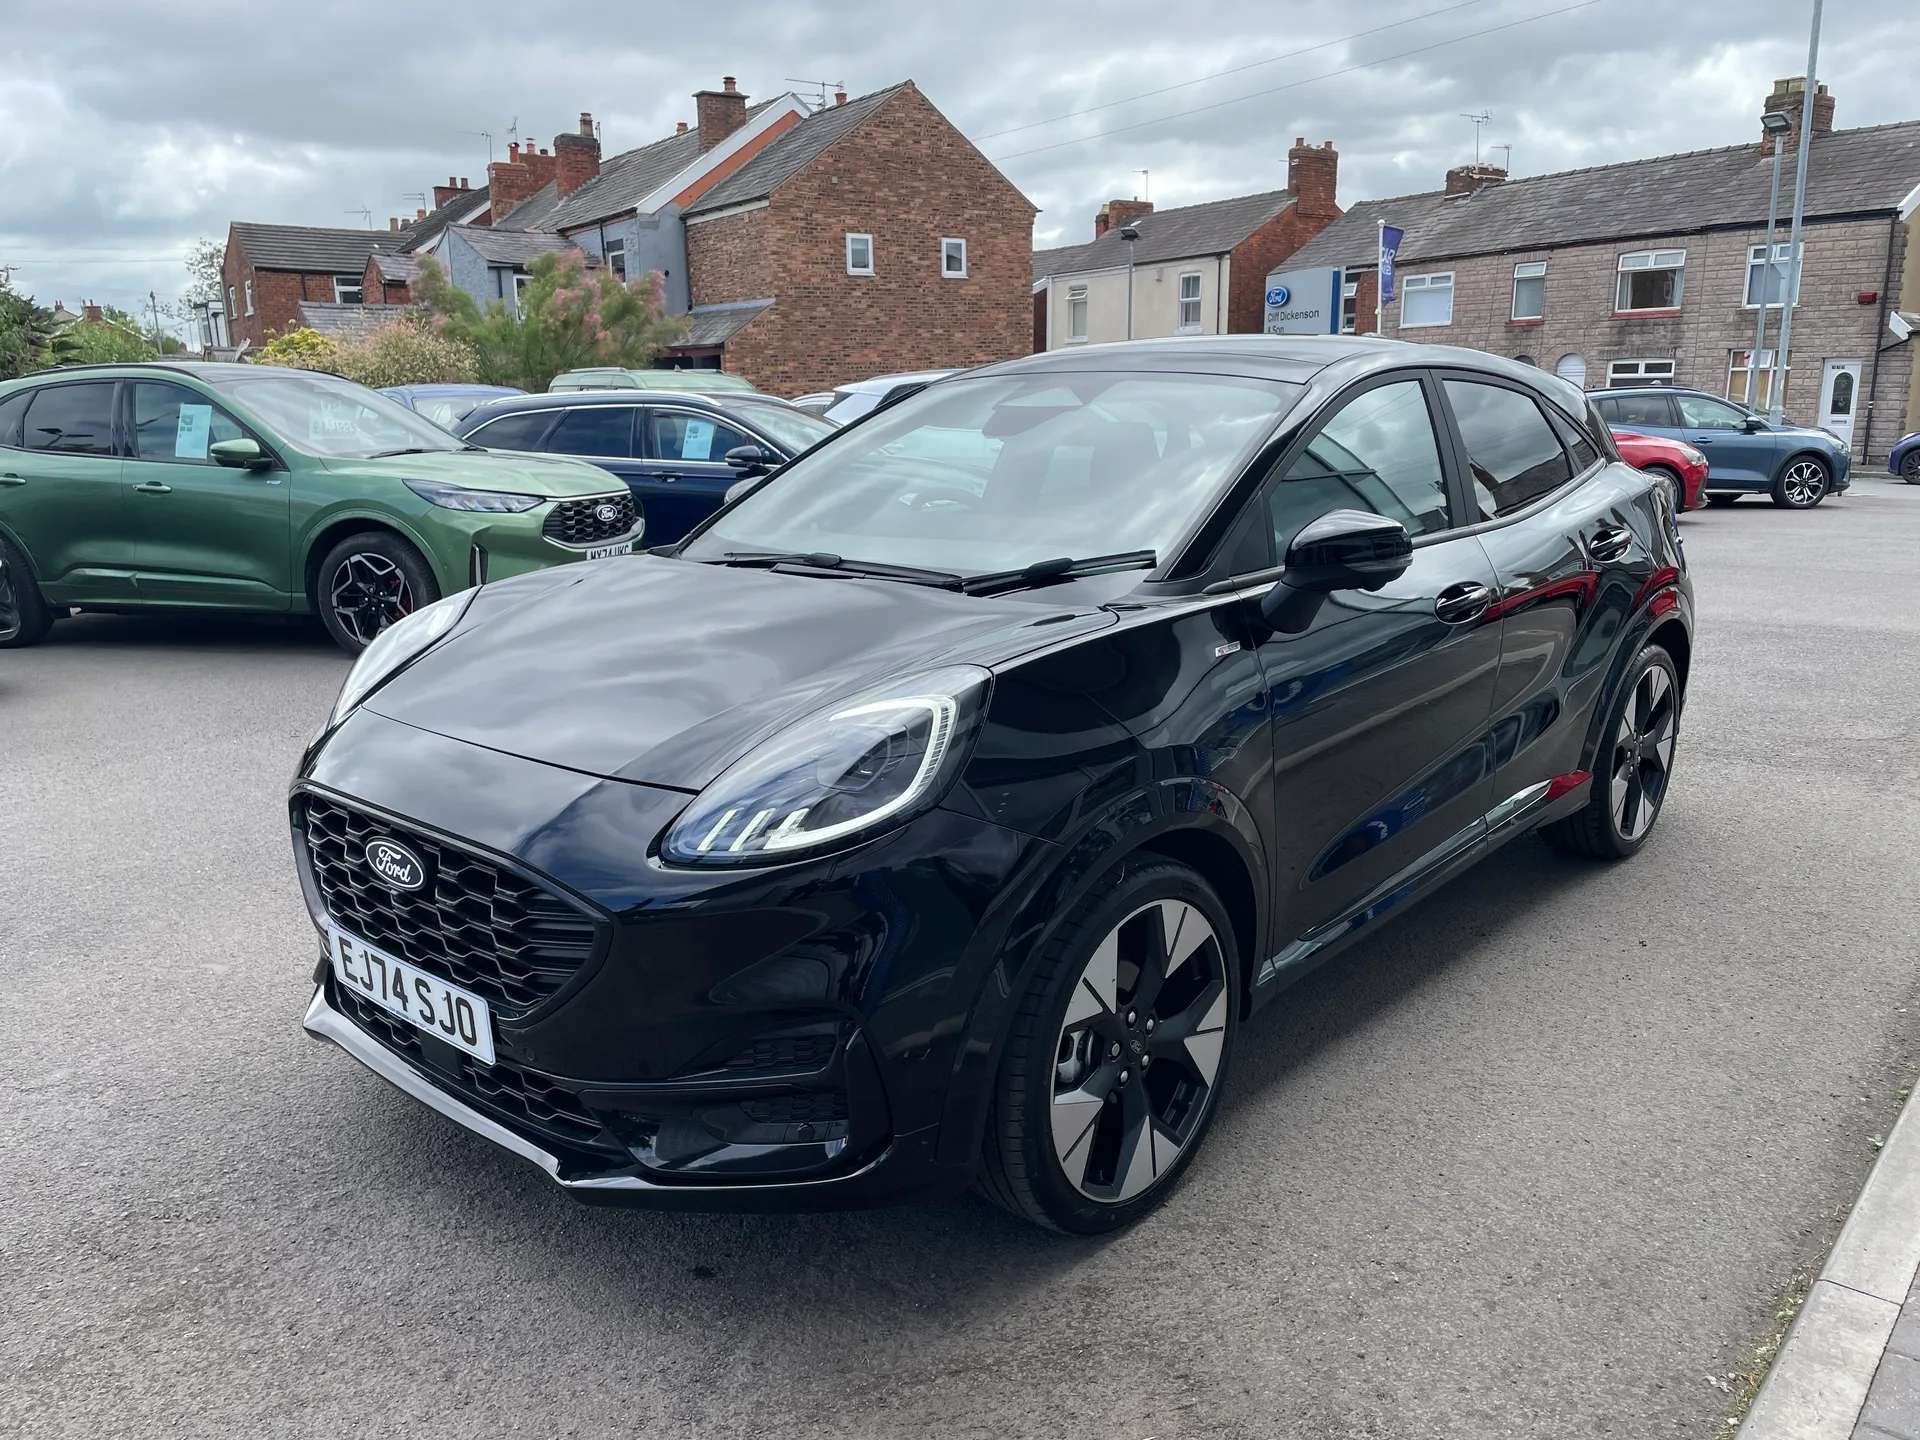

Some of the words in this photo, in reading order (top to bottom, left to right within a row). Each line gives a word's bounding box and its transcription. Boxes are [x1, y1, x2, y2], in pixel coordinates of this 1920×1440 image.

[1280, 309, 1320, 321] Dickenson
[375, 846, 412, 883] Ford
[339, 936, 409, 1012] EJ74
[414, 978, 478, 1047] SJO
